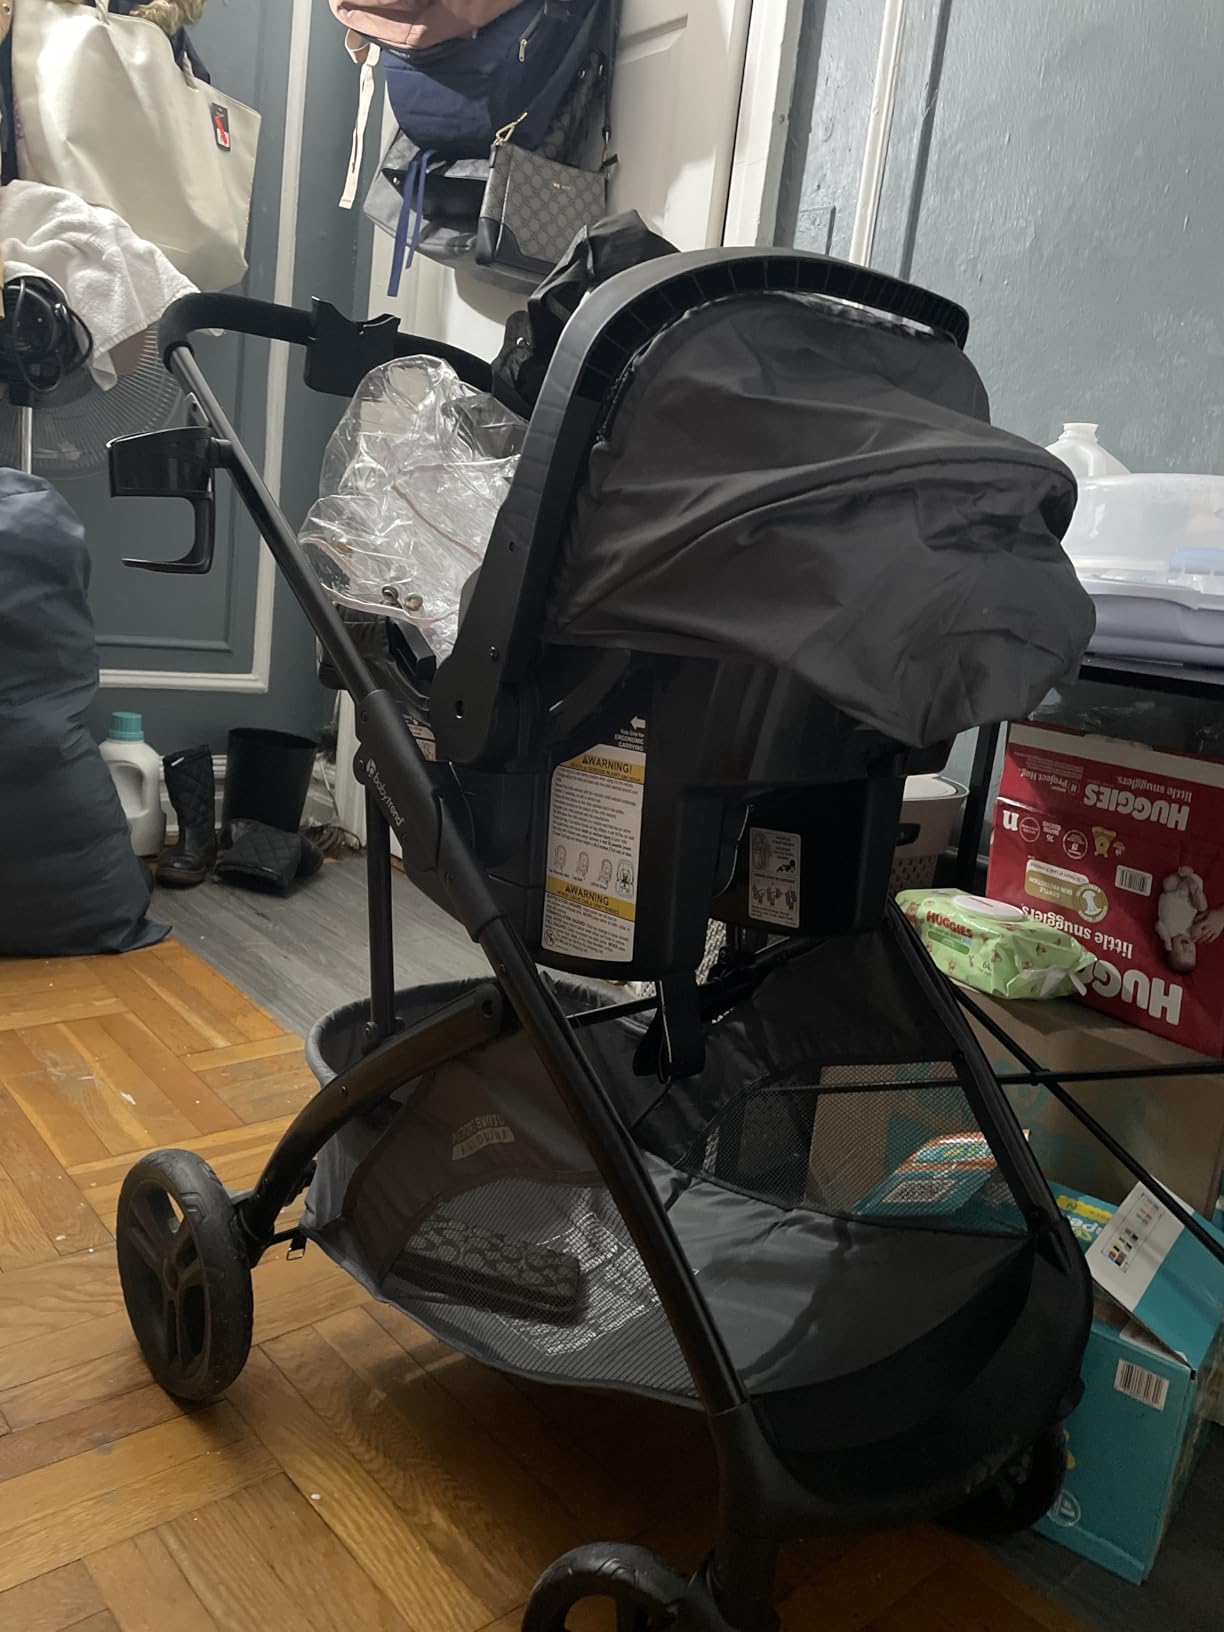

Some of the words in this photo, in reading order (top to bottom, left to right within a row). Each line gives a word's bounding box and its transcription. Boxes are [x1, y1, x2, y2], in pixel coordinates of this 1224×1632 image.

[588, 755, 632, 774] WARNING!
[1117, 776, 1166, 793] snugglers
[1167, 788, 1192, 802] little
[1083, 783, 1190, 832] HUGGIES
[570, 884, 609, 905] WARNING
[926, 910, 973, 938] HUGGIES
[1021, 905, 1091, 940] snugglers
[1095, 931, 1133, 959] little
